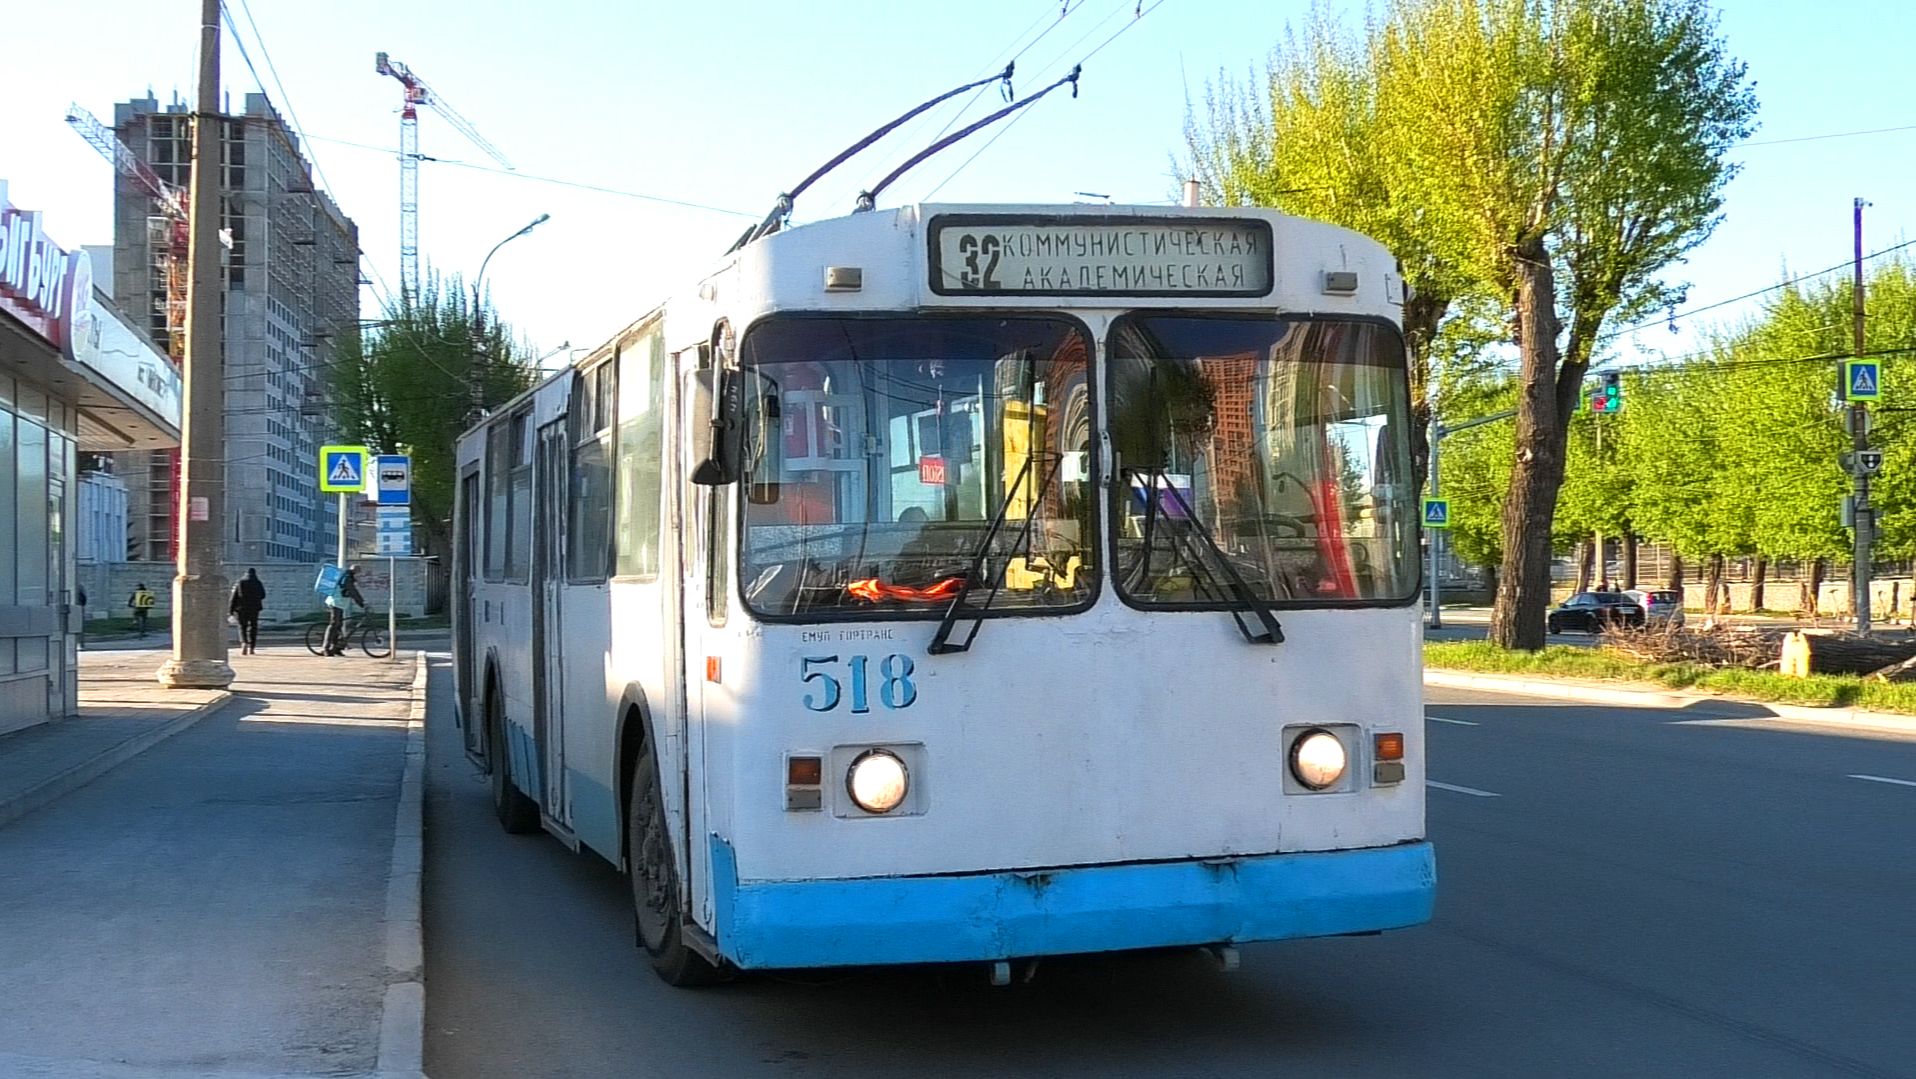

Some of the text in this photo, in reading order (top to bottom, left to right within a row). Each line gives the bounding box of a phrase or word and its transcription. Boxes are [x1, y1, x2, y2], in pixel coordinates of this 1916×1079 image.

[1002, 230, 1257, 258] КОММУНИСТИЧЕСКАЯ
[959, 234, 1001, 288] 32
[1023, 264, 1244, 290] АКАДЕМИЧЕСКАЯ
[802, 629, 893, 642] ЕМУП ГОРТРАНС
[801, 654, 917, 713] 518
